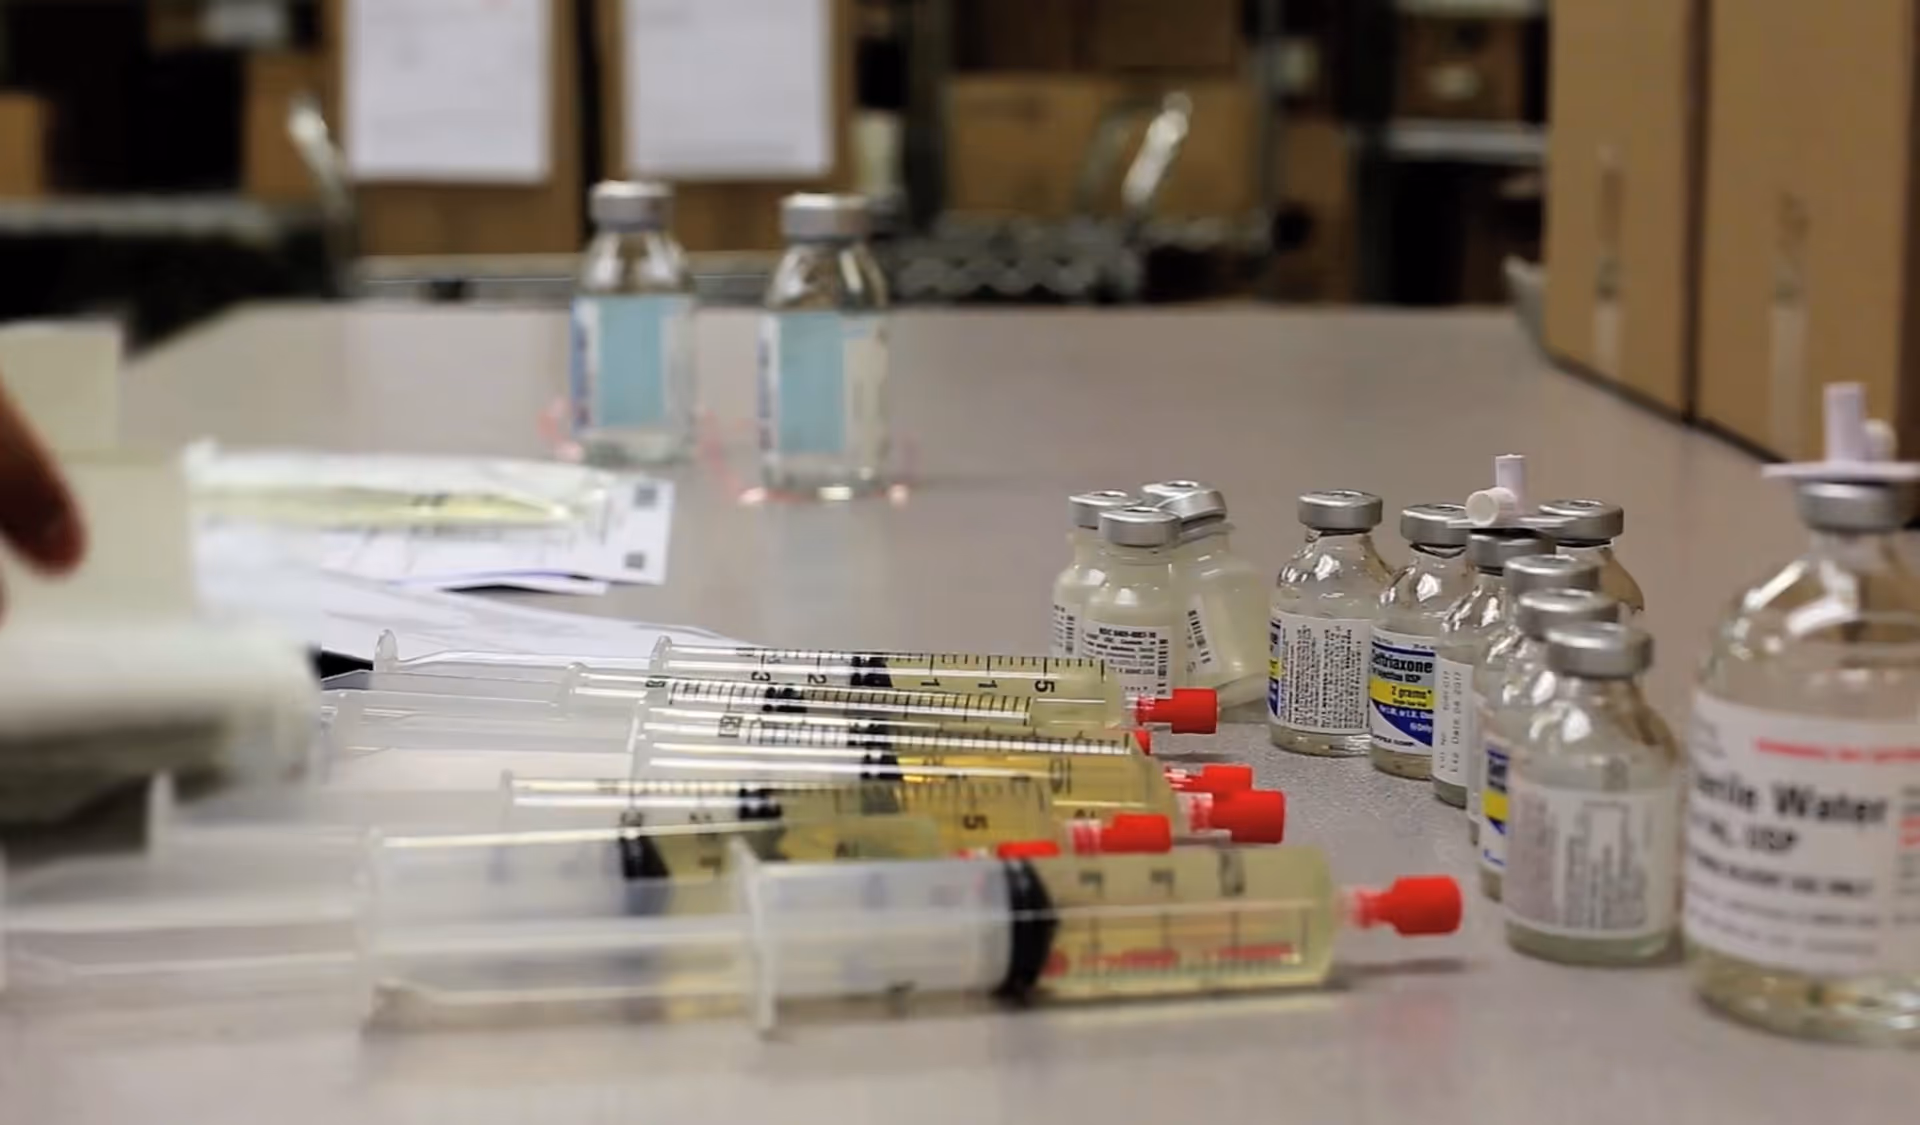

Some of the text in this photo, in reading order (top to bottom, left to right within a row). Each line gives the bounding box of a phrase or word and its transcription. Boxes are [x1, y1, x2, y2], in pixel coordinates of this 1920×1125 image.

[1034, 680, 1055, 692] 5
[1391, 685, 1396, 695] 2
[1771, 780, 1888, 826] Water
